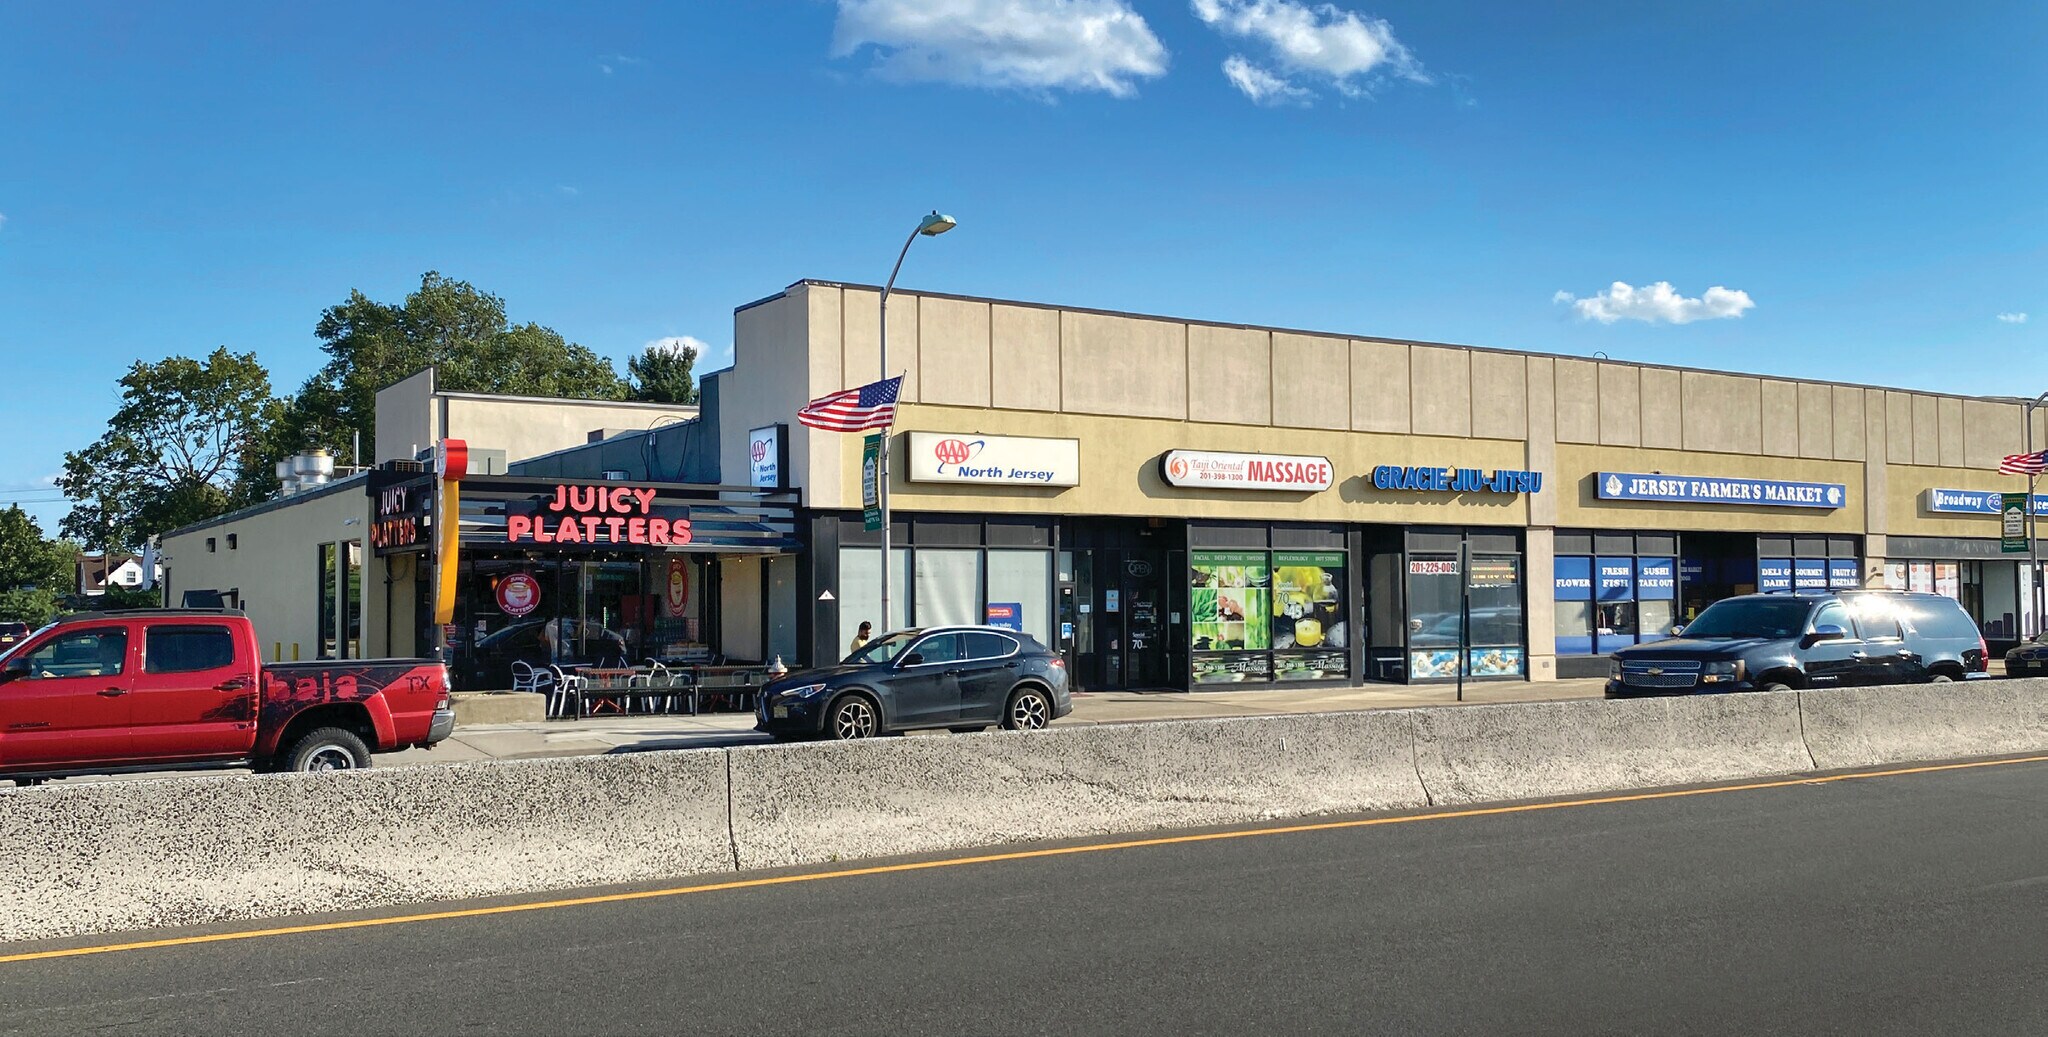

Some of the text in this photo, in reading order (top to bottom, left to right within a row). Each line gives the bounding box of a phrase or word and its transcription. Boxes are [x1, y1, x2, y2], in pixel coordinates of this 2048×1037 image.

[936, 441, 969, 464] AAA
[760, 463, 776, 472] North
[1190, 459, 1245, 473] Taiji Oriental
[958, 466, 1054, 482] North Jersey
[1199, 472, 1244, 481] 201-398-1300
[1247, 461, 1327, 484] MASSAGE
[1373, 465, 1450, 491] GRACIE
[1628, 478, 1823, 502] JERSEY FARMER'S MARKET
[380, 486, 407, 516] JUICY
[549, 484, 657, 514] JUICY
[1937, 492, 1983, 509] Broadway
[370, 516, 416, 548] PLATTERS
[507, 514, 693, 545] PLATTERS
[1602, 567, 1629, 575] FRESH
[1643, 567, 1669, 575] SUSHI
[1761, 568, 1792, 576] DELI &
[1795, 568, 1823, 576] GOURMET
[1832, 568, 1857, 576] FRUIT &
[1556, 579, 1591, 588] FLOWER
[1602, 579, 1628, 588] FISH
[1639, 579, 1674, 587] TAKE OUT
[1763, 579, 1789, 587] DAIRY
[1795, 579, 1827, 587] GROCERIES
[1277, 592, 1289, 604] 70
[504, 603, 534, 613] PLATTERS
[1132, 640, 1142, 649] 70
[263, 671, 358, 703] baja
